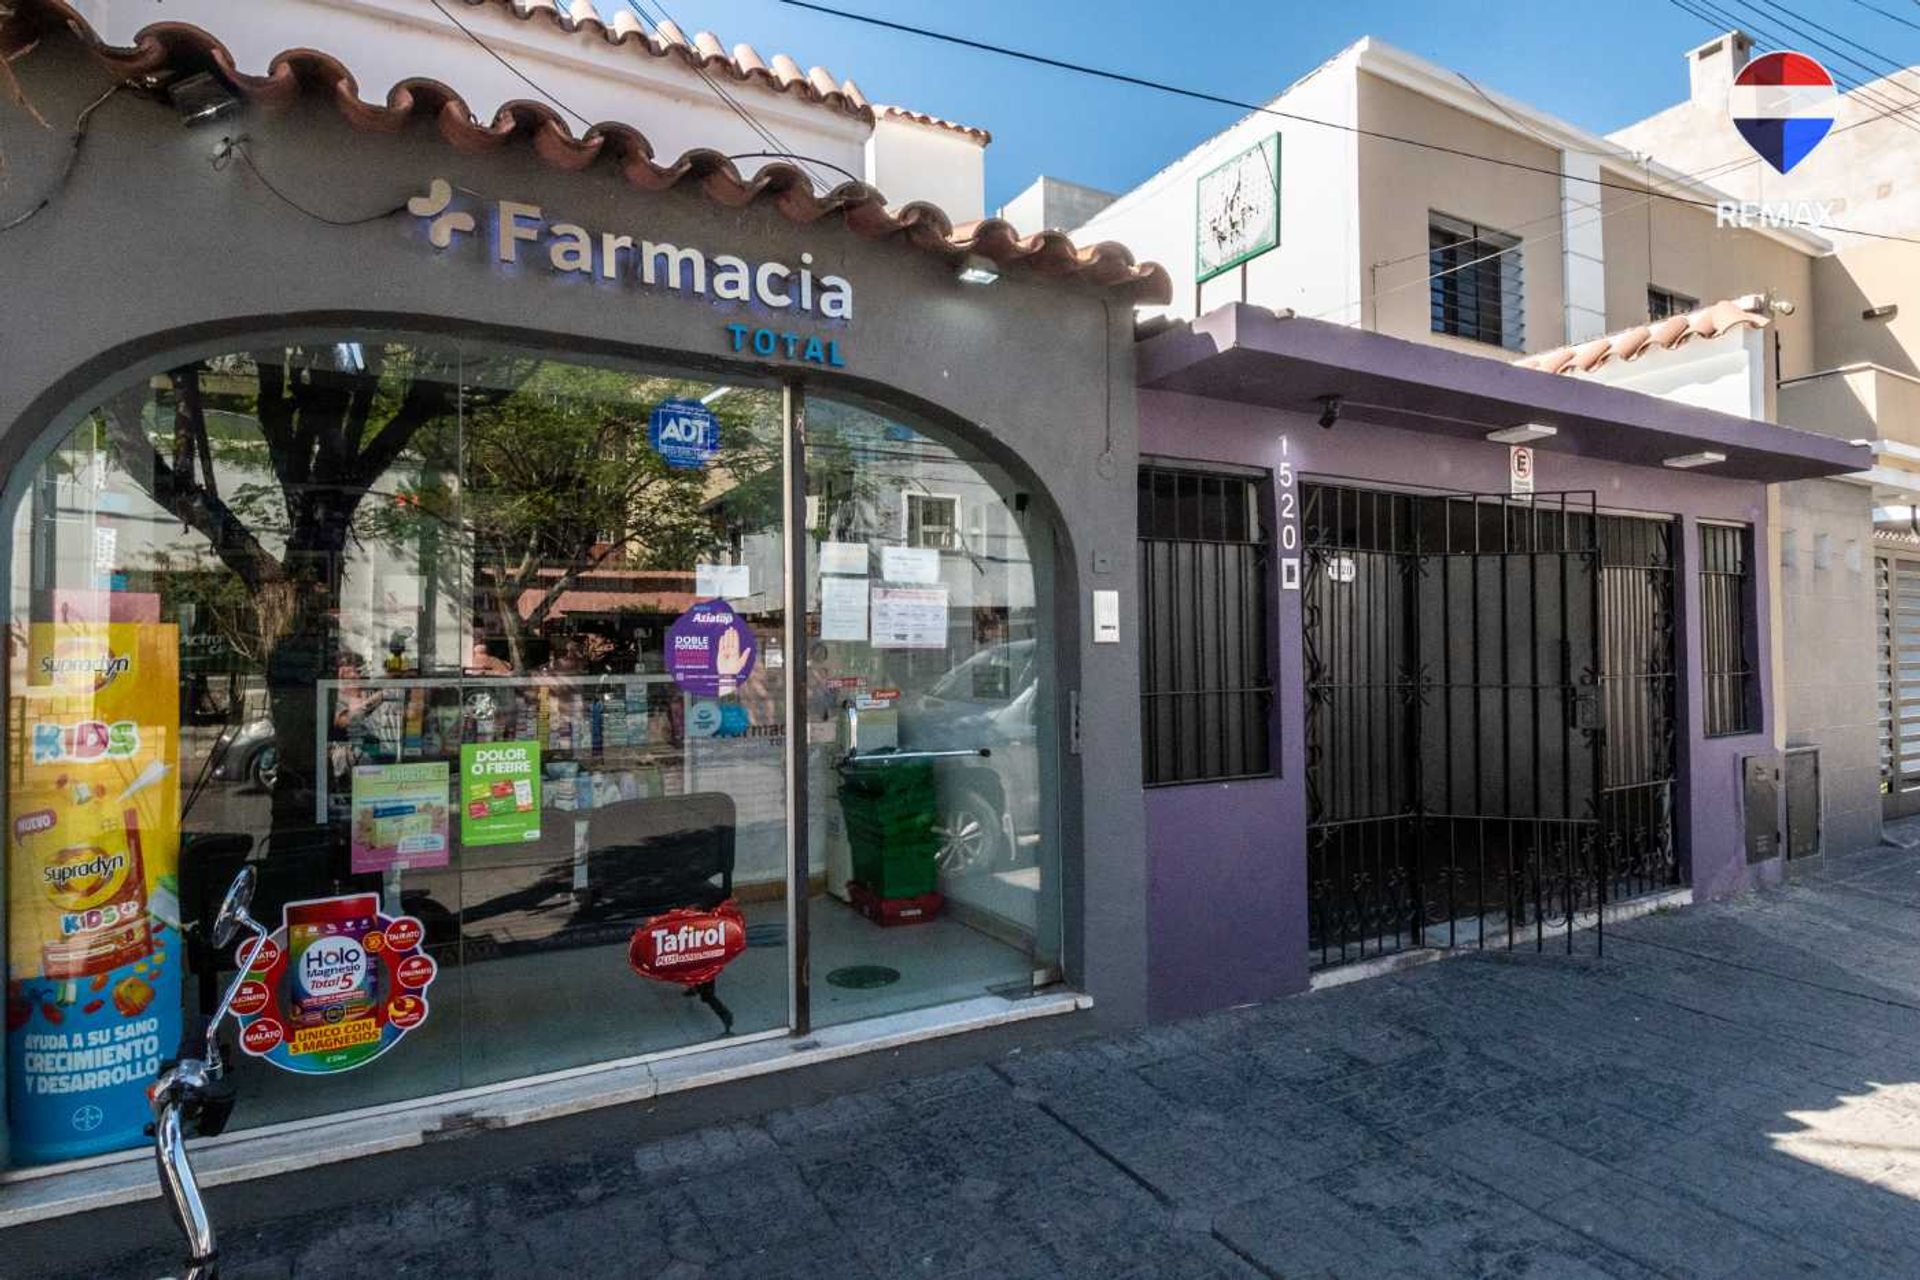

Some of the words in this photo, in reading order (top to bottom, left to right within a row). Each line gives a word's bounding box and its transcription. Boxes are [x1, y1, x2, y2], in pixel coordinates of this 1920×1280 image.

[499, 200, 853, 320] Farmacia
[726, 323, 846, 367] TOTAL
[660, 416, 709, 444] ADT
[1516, 454, 1527, 473] E
[675, 636, 709, 645] DOBLE
[40, 654, 130, 676] Supradyn
[35, 722, 138, 763] KIDS
[476, 748, 527, 762] DOLOR
[471, 763, 484, 775] O
[486, 760, 532, 775] FIEBRE
[44, 854, 124, 881] Supradyn
[62, 907, 119, 934] KIDS
[651, 920, 726, 956] Tafirol
[306, 946, 361, 969] Holo
[306, 963, 361, 978] Magnesio
[310, 976, 341, 990] Total
[339, 973, 354, 990] 5
[24, 1034, 69, 1050] AYUDA
[72, 1033, 84, 1048] A
[87, 1027, 111, 1047] SU
[114, 1017, 159, 1042] SANO
[245, 1029, 281, 1043] MALATO
[343, 1021, 373, 1036] CON
[302, 1029, 380, 1053] MAGNESIOS
[24, 1035, 159, 1074] CRECIMIENTO
[25, 1075, 34, 1094] Y
